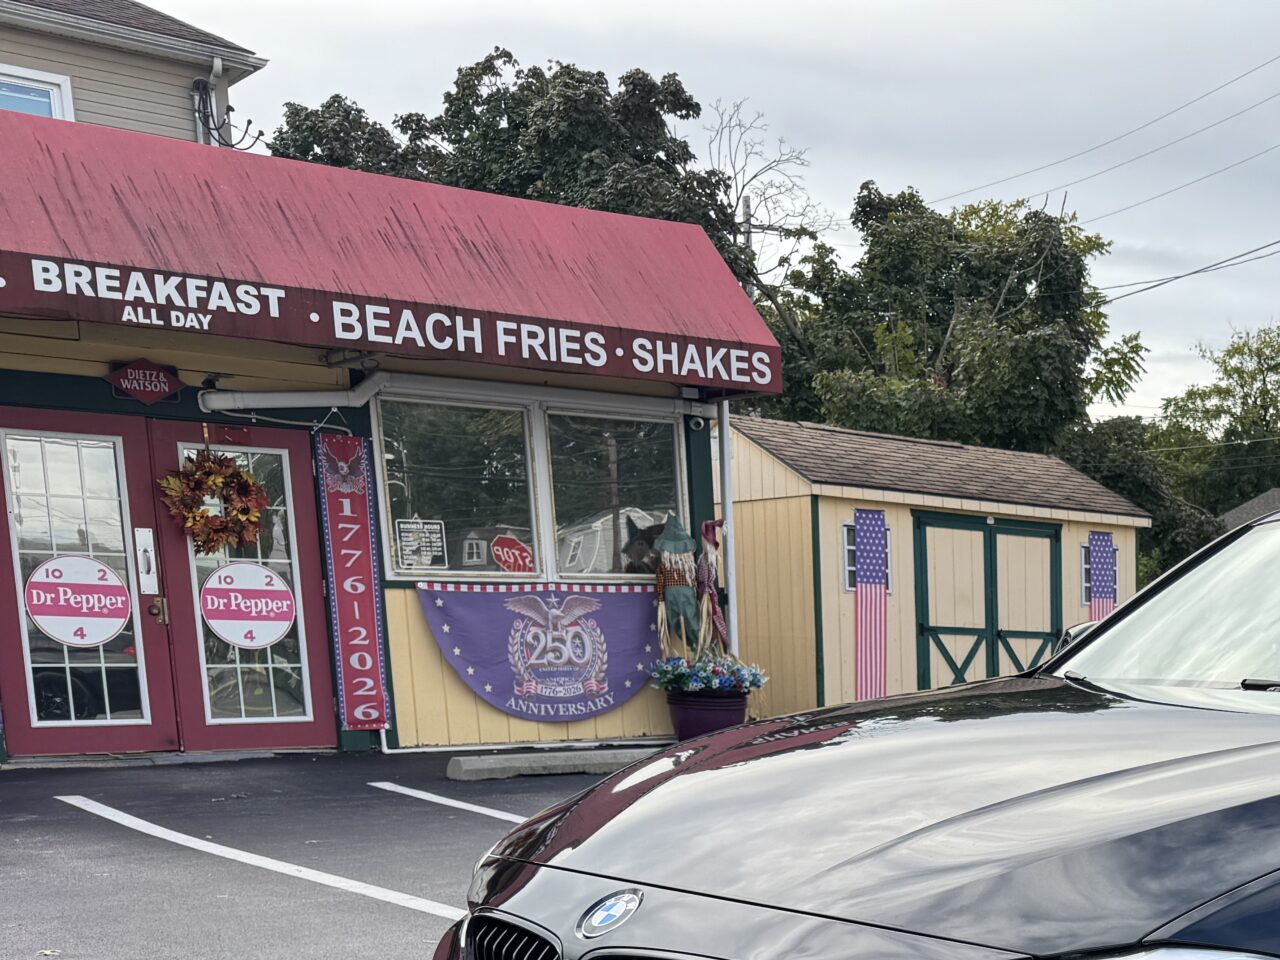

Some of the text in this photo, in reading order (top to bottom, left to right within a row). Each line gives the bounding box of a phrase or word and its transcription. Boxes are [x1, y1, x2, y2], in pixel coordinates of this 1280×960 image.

[31, 258, 286, 318] BREAKFAST
[121, 305, 213, 330] ALL DAY
[332, 301, 608, 367] BEACH FRIES
[632, 337, 772, 385] SHAKES
[120, 378, 169, 393] WATSON
[127, 368, 168, 382] DIETZ &
[45, 568, 109, 582] 10 2
[218, 574, 275, 587] 10 2
[30, 586, 126, 613] Dr Pepper
[205, 591, 291, 617] Dr Pepper
[73, 626, 88, 640] 4
[243, 629, 256, 642] 4
[525, 629, 592, 665] 250
[505, 692, 616, 717] ANNIVERSARY
